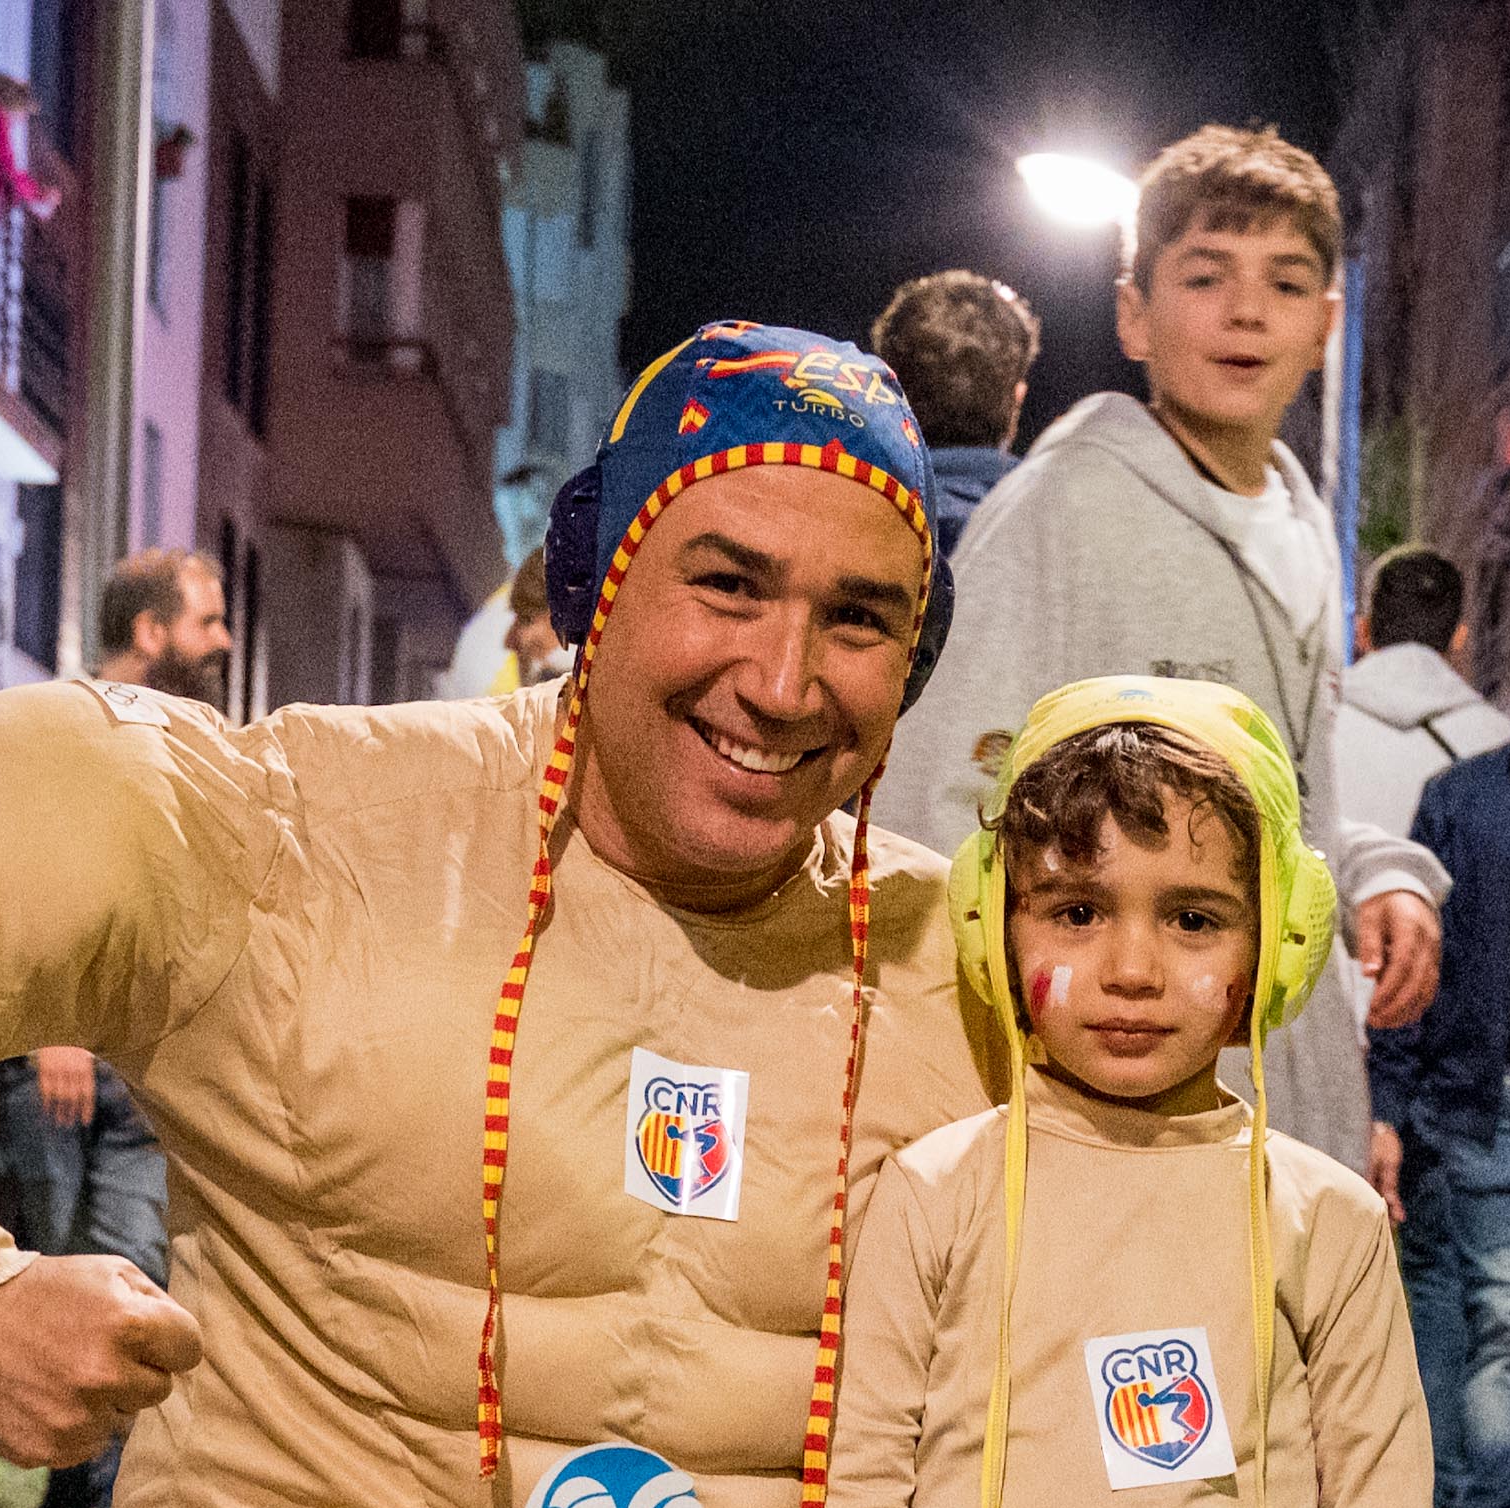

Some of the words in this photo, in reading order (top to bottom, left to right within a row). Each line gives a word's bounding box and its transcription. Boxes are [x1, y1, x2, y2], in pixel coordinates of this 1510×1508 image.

[793, 351, 897, 406] ESP
[773, 399, 866, 429] TURBO
[653, 1086, 722, 1117] CNR
[1111, 1349, 1189, 1384] CNR
